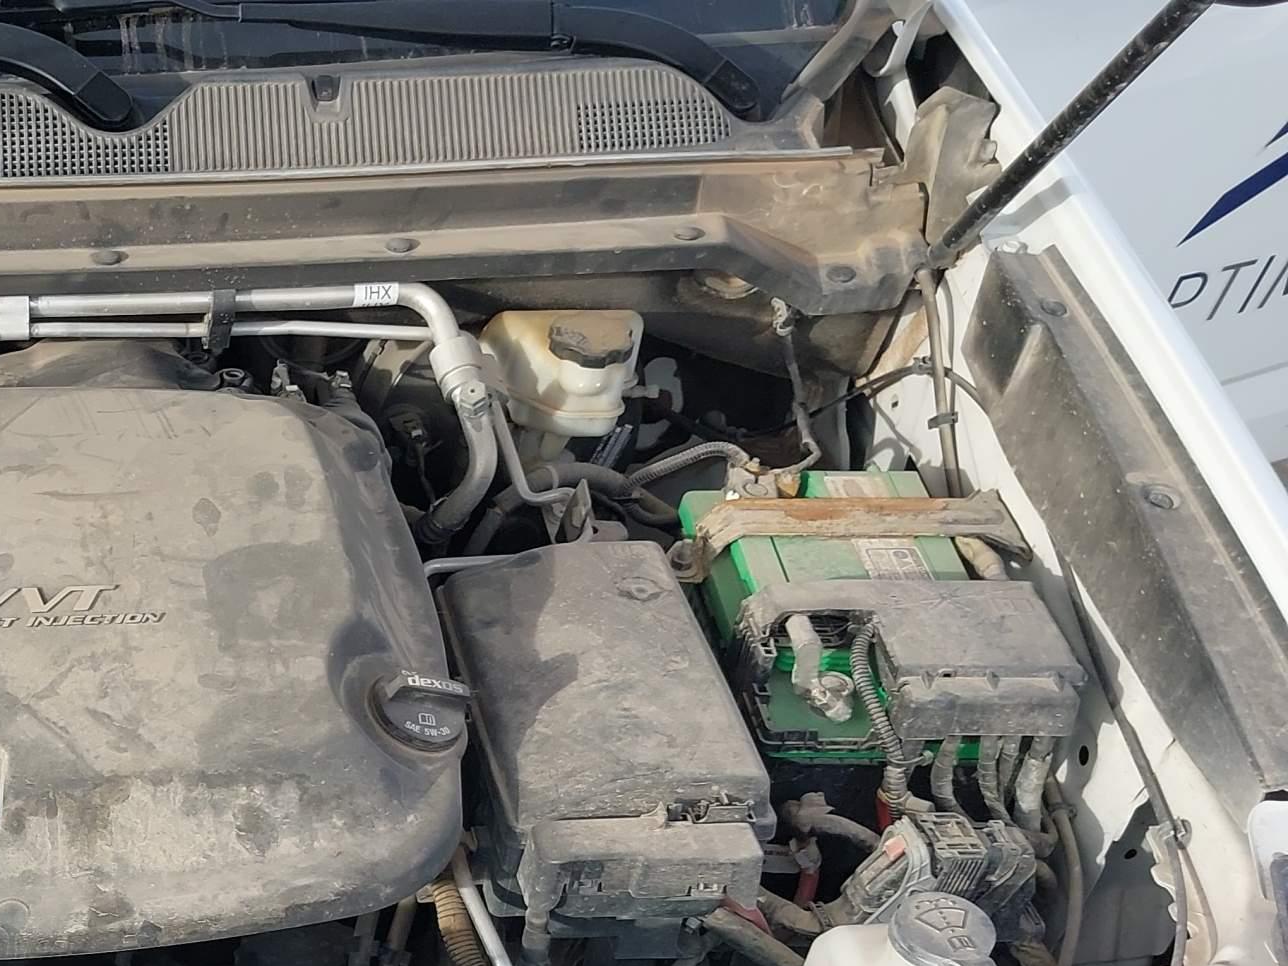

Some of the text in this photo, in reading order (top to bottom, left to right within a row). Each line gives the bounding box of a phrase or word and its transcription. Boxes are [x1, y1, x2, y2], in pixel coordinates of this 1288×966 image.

[364, 285, 393, 300] IHX
[26, 612, 166, 628] INJECTION
[407, 675, 464, 693] dexos
[404, 721, 451, 737] SAE 5W-30
